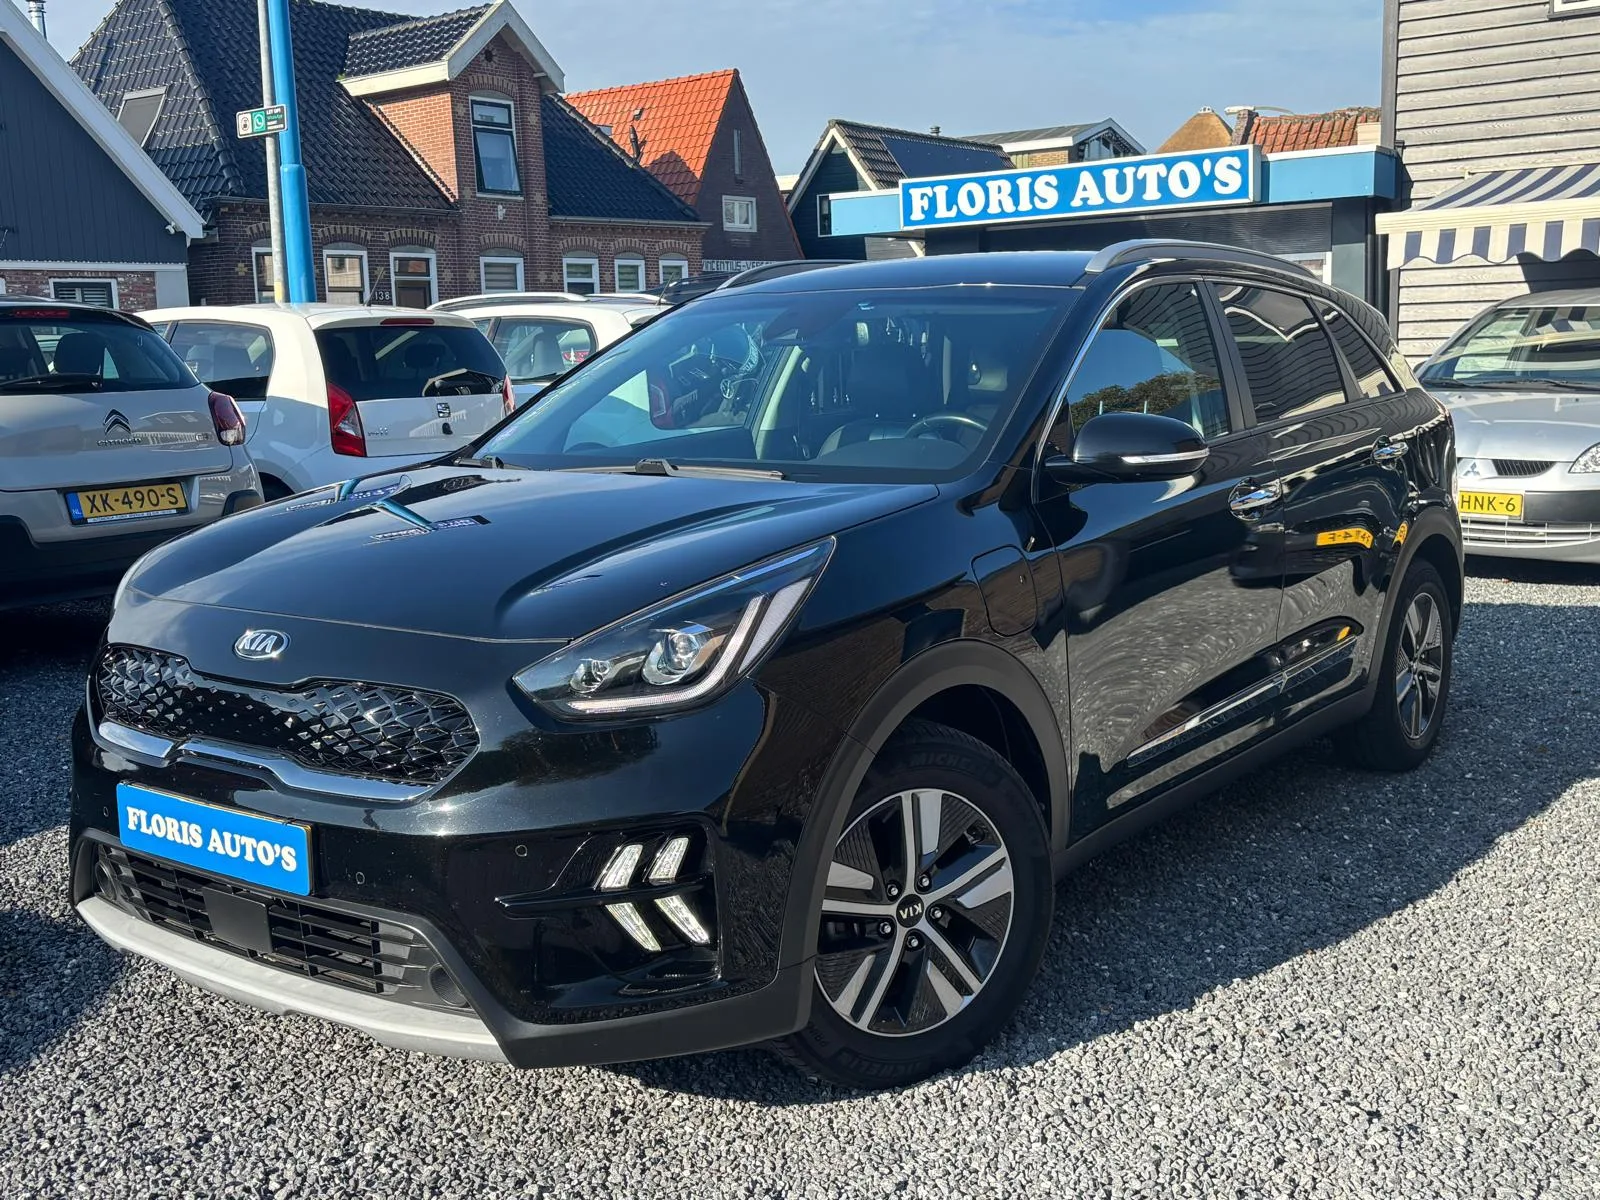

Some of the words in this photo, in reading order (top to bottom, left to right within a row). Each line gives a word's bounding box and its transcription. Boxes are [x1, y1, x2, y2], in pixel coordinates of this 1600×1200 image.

[909, 174, 1059, 221] FLORIS
[1070, 156, 1243, 207] AUTO'S
[375, 291, 390, 300] 138
[86, 487, 179, 513] XK-490-S
[1461, 495, 1516, 512] HNK-6
[238, 632, 278, 653] KIA
[126, 806, 203, 848] FLORIS
[207, 828, 297, 872] AUTO'S
[899, 903, 922, 919] KIA
